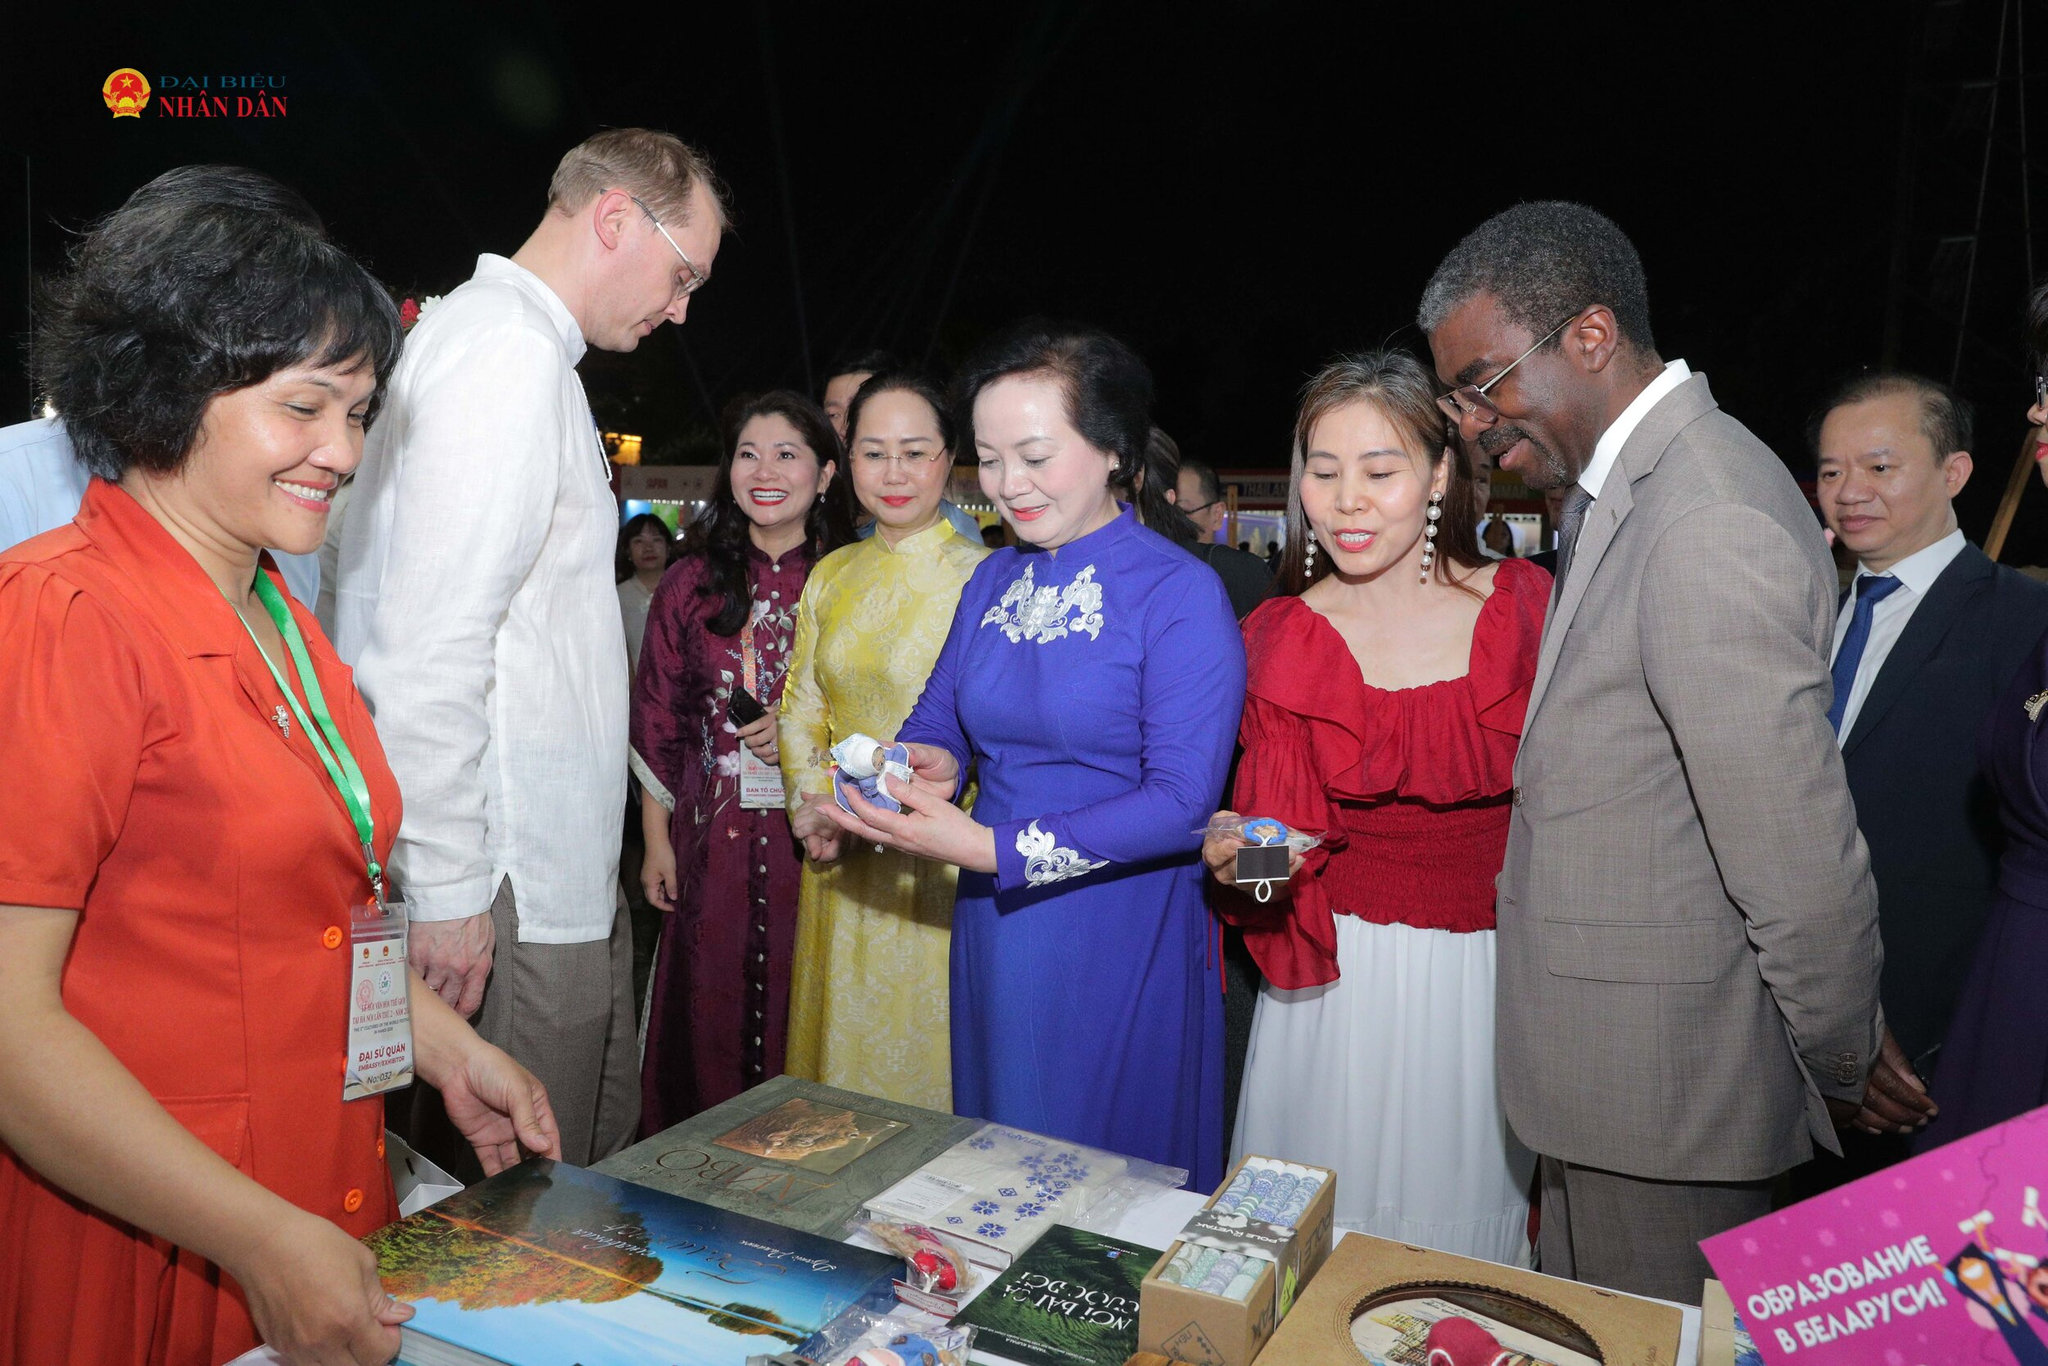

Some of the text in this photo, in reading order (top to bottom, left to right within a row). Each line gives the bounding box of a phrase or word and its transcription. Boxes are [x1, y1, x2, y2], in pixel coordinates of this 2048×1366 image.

[1243, 481, 1289, 497] THAILAN
[359, 1051, 373, 1063] ĐẠI
[1245, 1232, 1278, 1244] POLE
[1747, 1234, 1940, 1322] ОБРАЗОВАНИЕ
[1774, 1277, 1949, 1354] В БЕЛАРУСИ!
